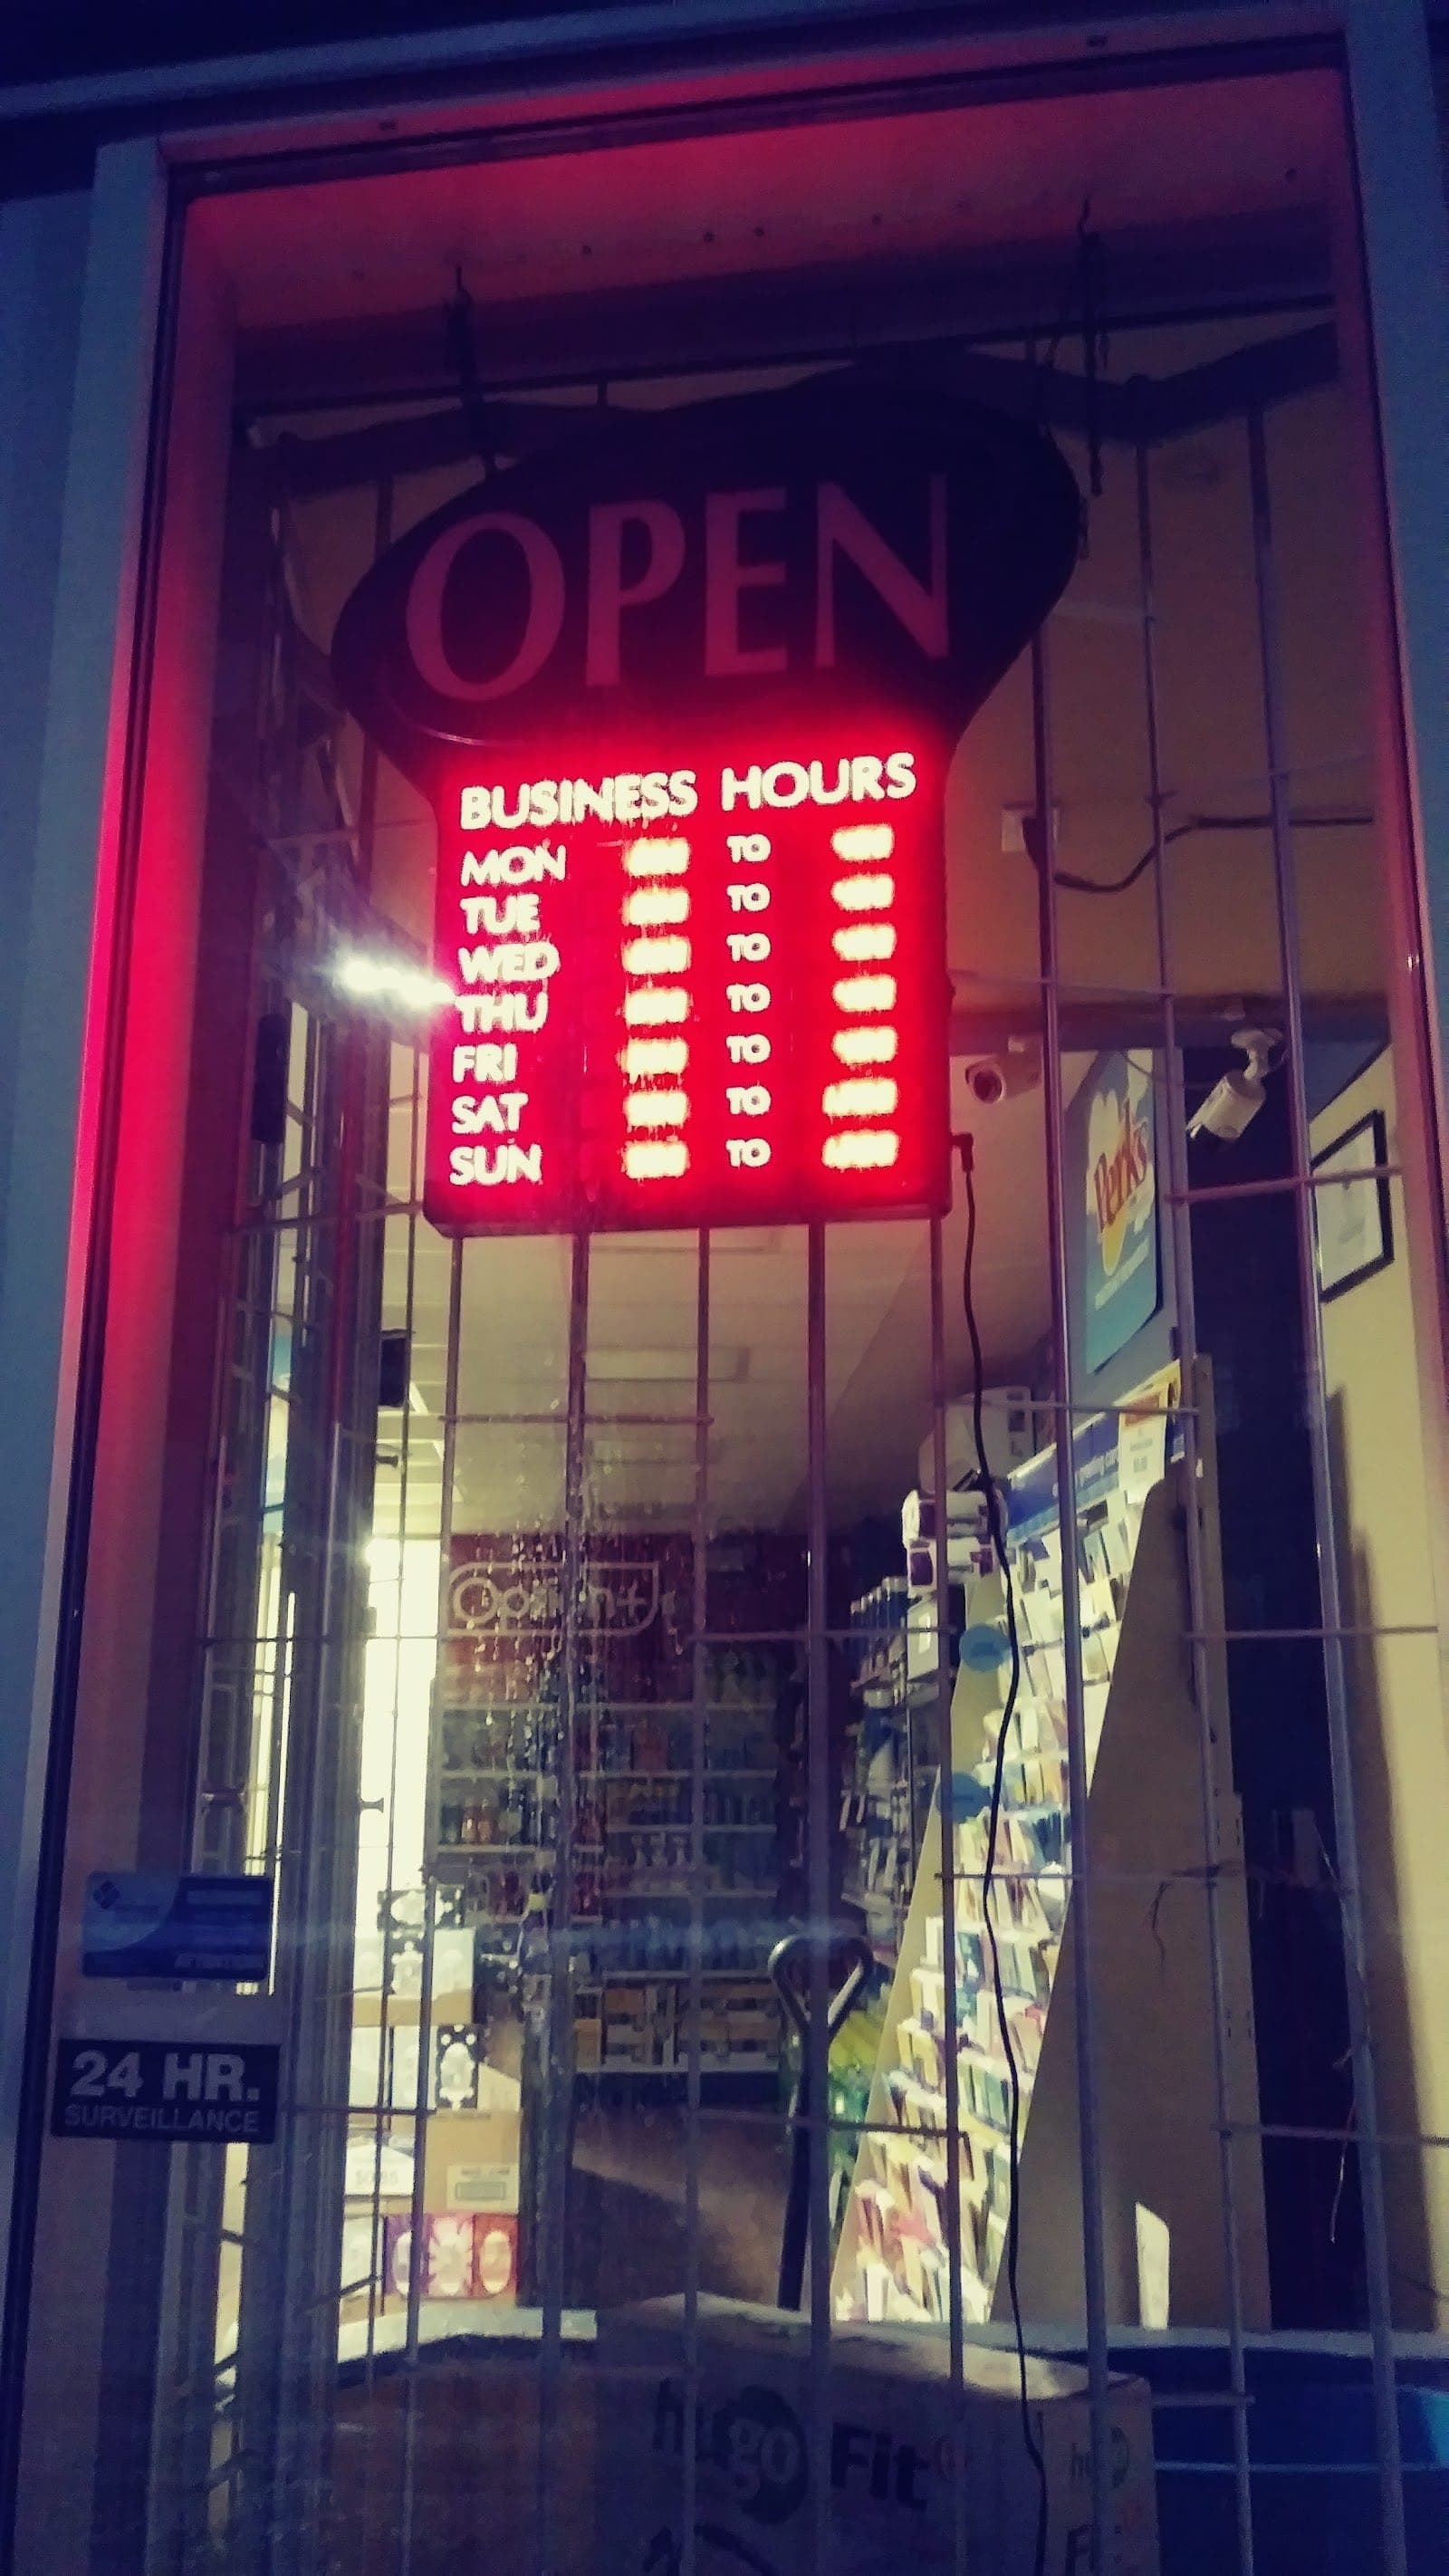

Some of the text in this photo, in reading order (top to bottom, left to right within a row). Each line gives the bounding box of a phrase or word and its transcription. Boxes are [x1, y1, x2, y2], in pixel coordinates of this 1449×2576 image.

[406, 473, 951, 702] OPEN
[460, 751, 916, 830] BUSINESS HOURS
[460, 844, 566, 887] MON
[726, 833, 771, 862] TO
[459, 893, 541, 934] TUE
[726, 882, 771, 912] TO
[457, 941, 561, 984] WED
[726, 932, 771, 962] TO
[455, 991, 549, 1033] THU
[726, 983, 771, 1012] TO
[452, 1043, 518, 1083] FRI
[725, 1033, 771, 1063] TO
[451, 1091, 529, 1134] SAT
[725, 1085, 771, 1115] TO
[449, 1143, 542, 1186] SUN
[725, 1138, 771, 1167] TO
[71, 2049, 261, 2102] 24 HR.
[64, 2102, 261, 2134] SURVEILLANCE
